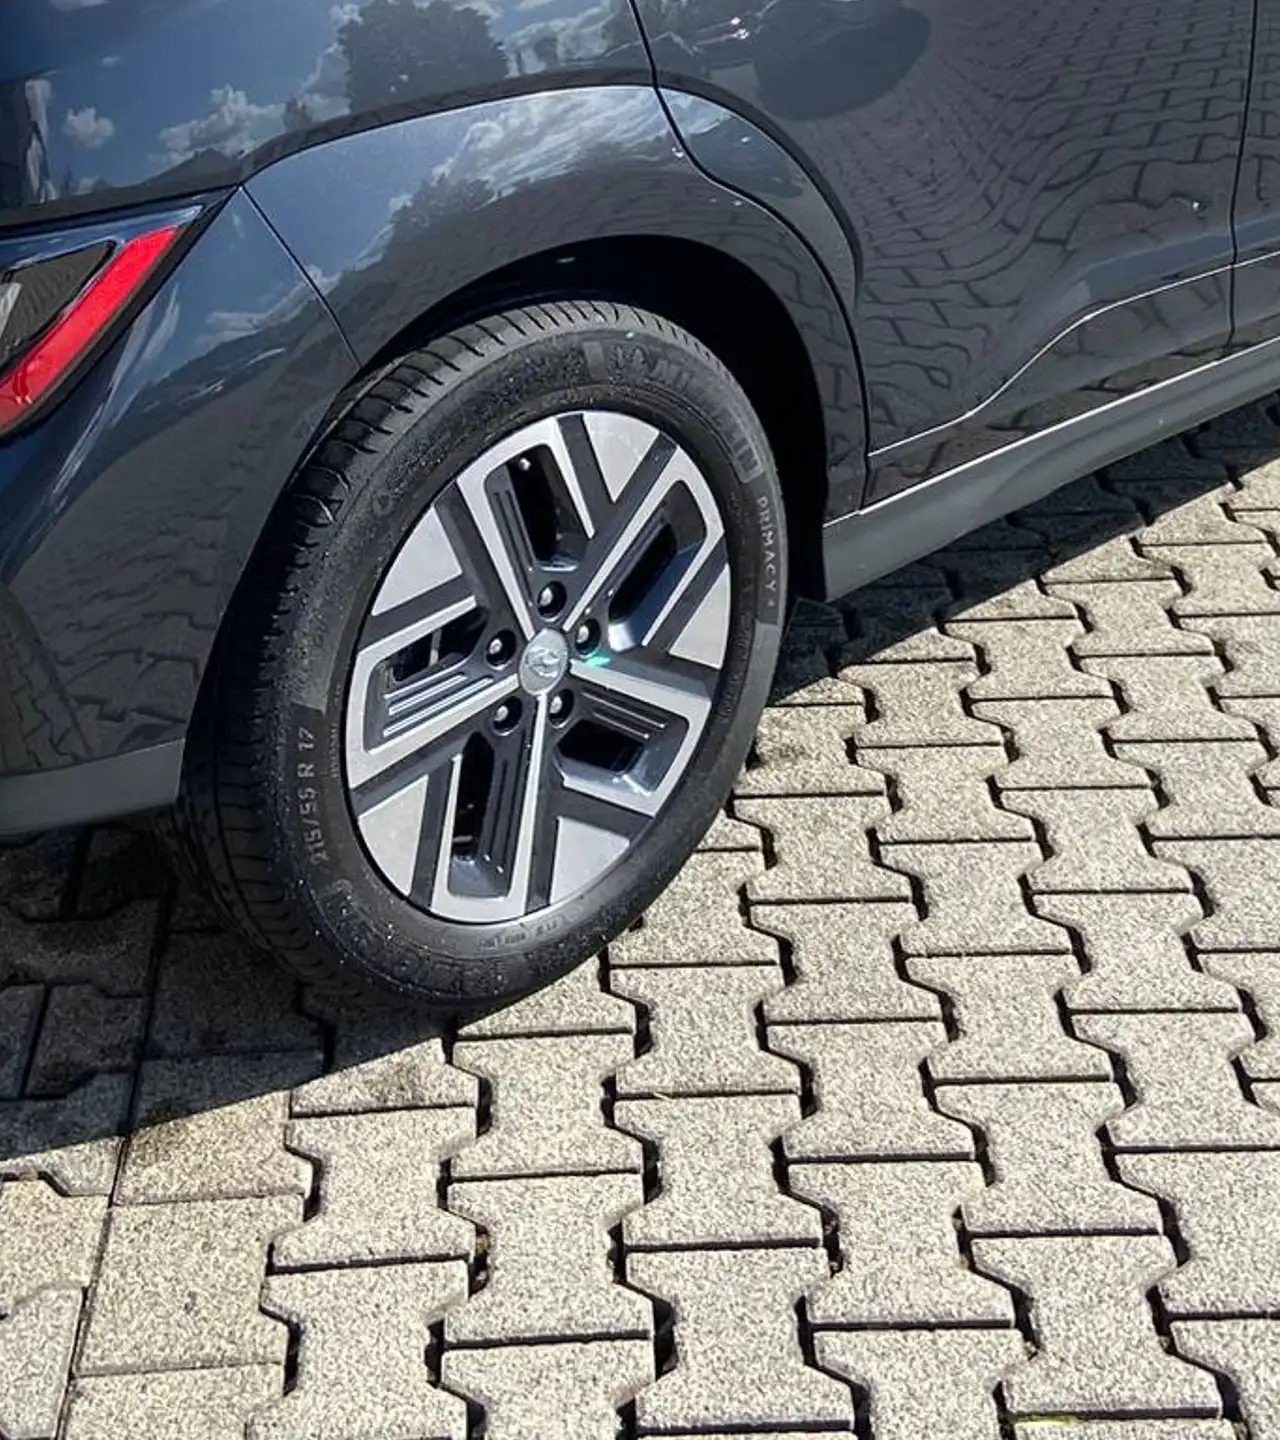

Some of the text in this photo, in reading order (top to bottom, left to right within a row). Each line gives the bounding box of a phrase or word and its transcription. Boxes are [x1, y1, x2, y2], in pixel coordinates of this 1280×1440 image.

[756, 495, 777, 593] PRIMACY
[296, 725, 329, 865] 215/55 R 17
